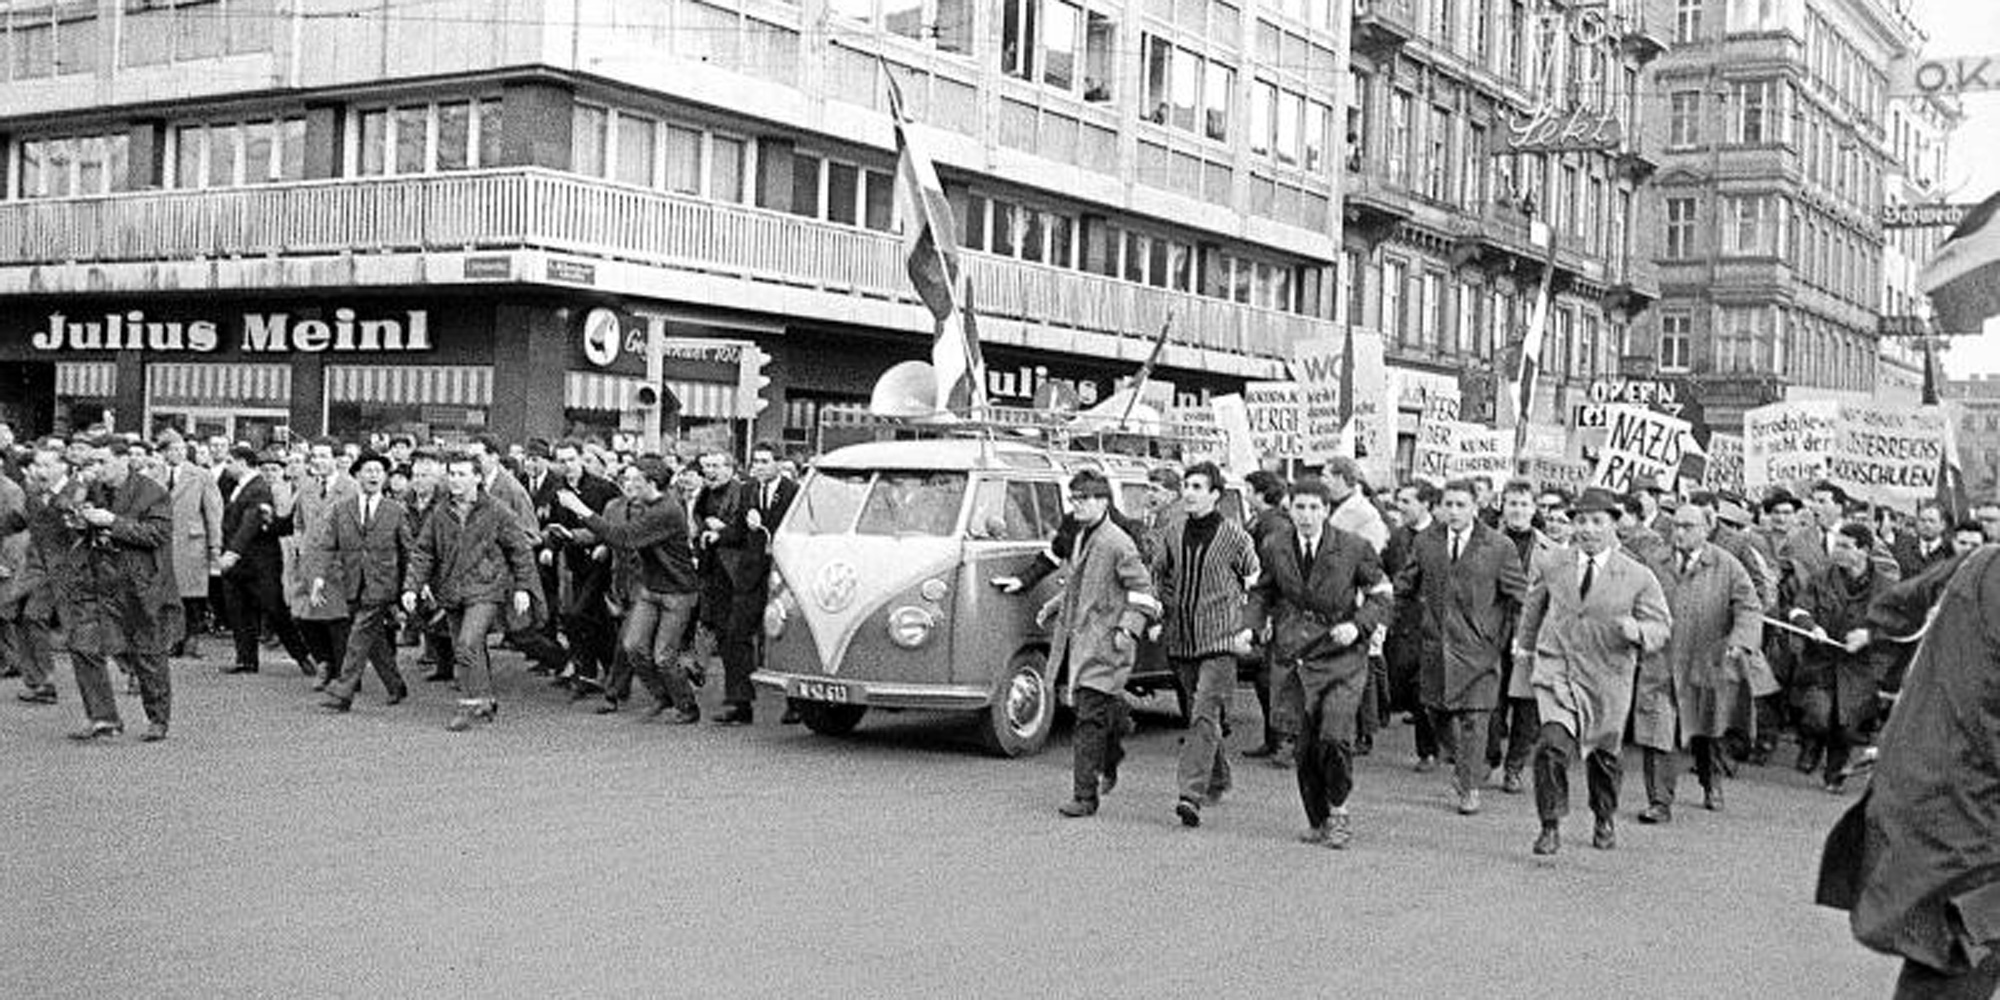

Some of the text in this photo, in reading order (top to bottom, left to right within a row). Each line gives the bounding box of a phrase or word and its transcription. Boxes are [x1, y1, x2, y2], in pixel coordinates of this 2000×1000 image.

[32, 307, 431, 352] Julius Meinl
[1611, 412, 1687, 466] NAZIS
